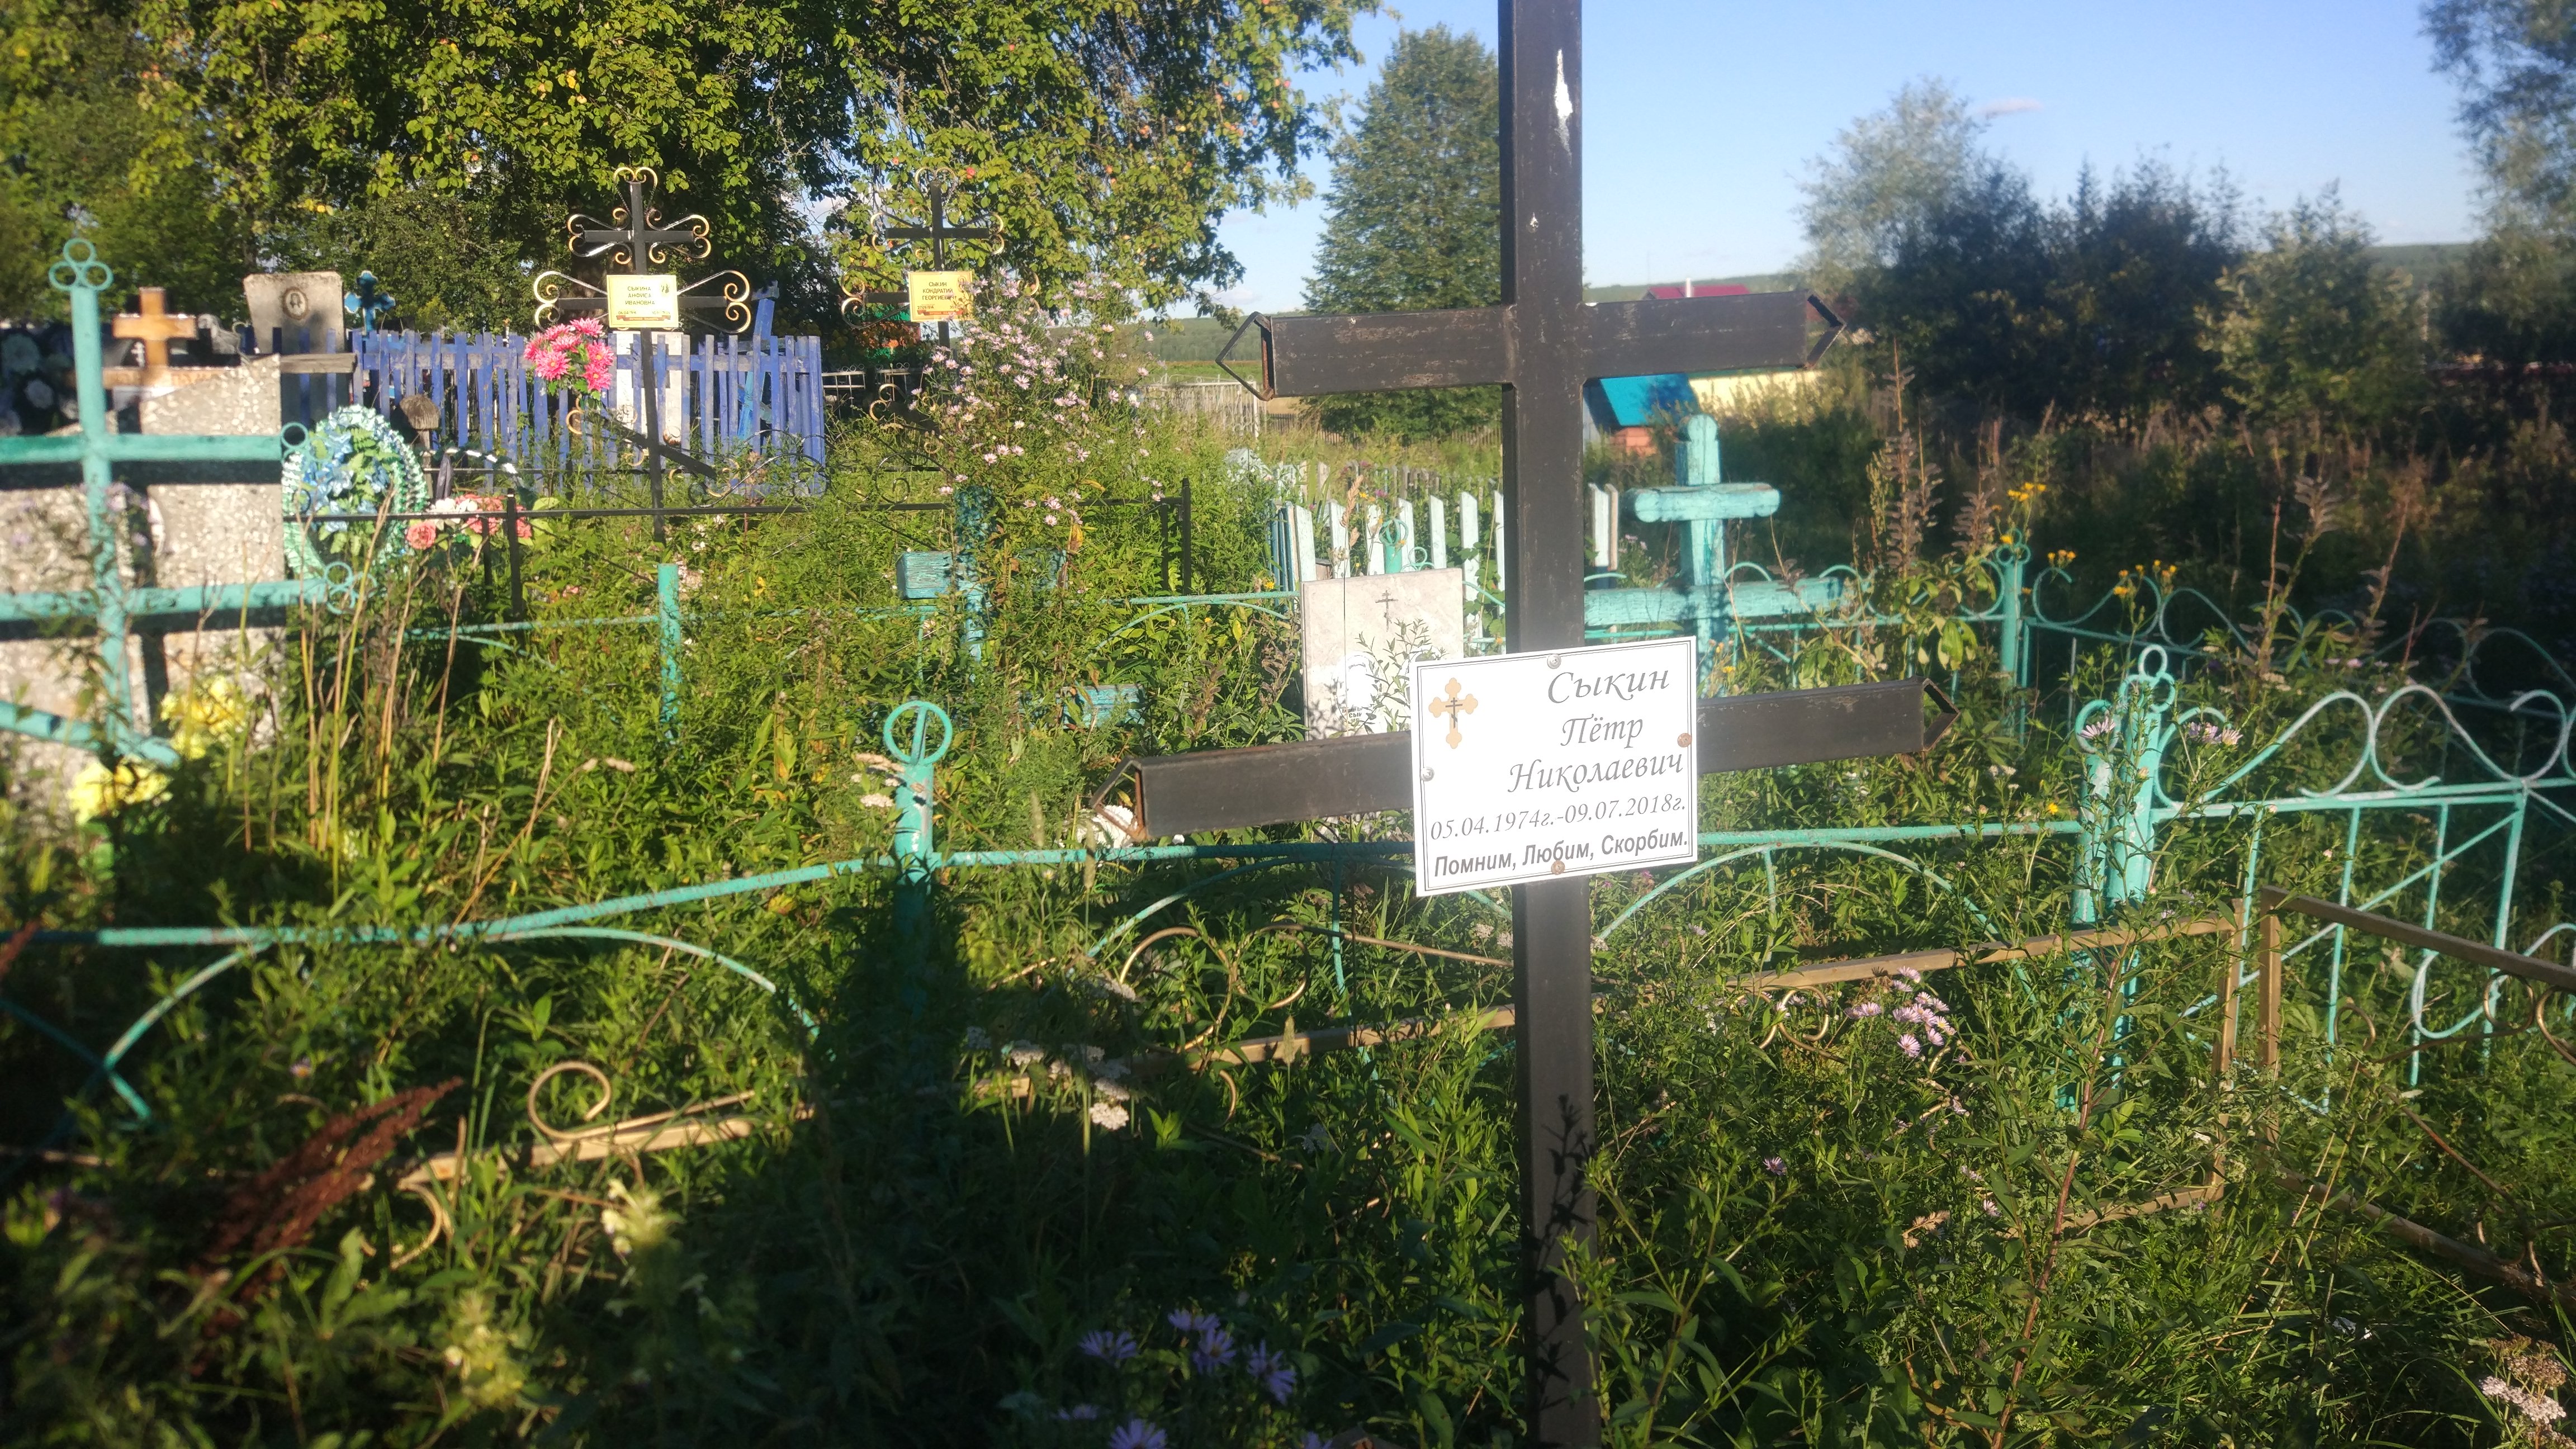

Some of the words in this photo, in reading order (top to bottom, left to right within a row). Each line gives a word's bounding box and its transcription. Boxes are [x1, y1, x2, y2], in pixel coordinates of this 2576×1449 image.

[1548, 670, 1670, 704] Сыкин
[1560, 713, 1643, 749] Пётр
[1507, 754, 1683, 793] Николаевич
[1434, 853, 1516, 877] Помним,
[1522, 840, 1594, 866] Любим,
[1601, 829, 1688, 856] Скорбим.
